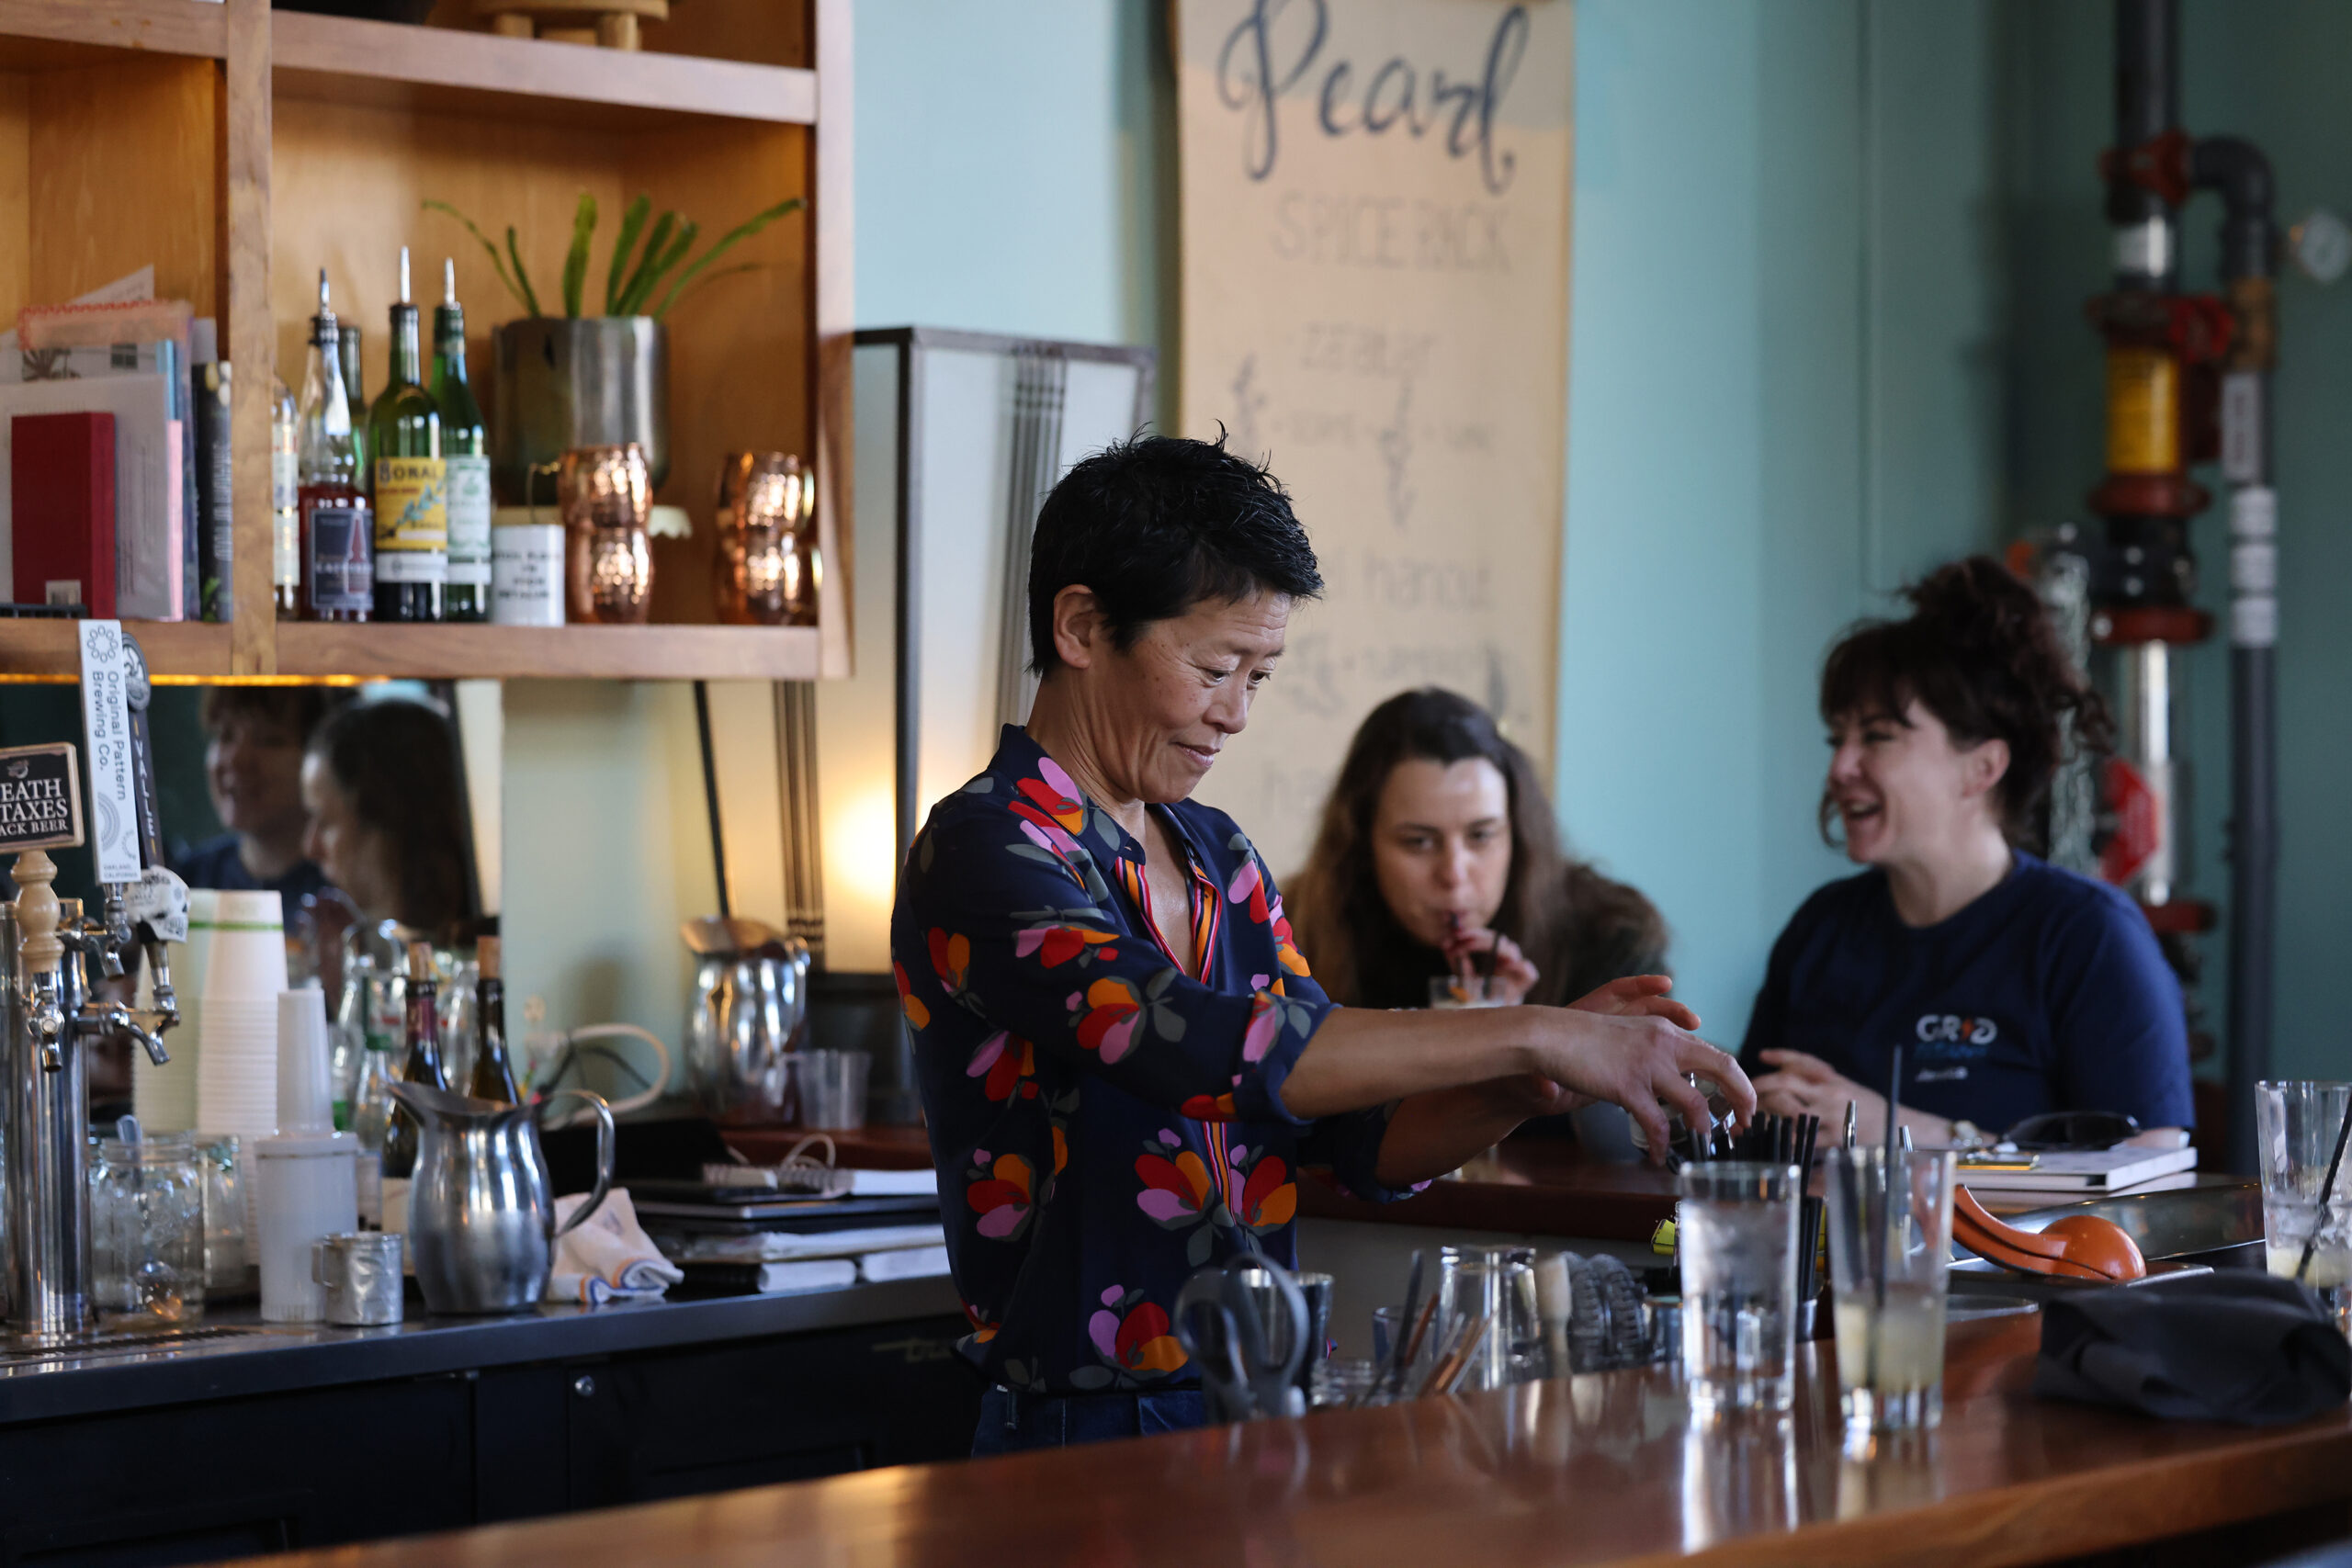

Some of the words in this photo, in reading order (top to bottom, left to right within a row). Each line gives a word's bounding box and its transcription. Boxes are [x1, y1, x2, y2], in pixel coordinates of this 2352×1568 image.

[1216, 0, 1530, 196] Pearl
[92, 671, 107, 739] Brewing
[107, 671, 125, 736] Original
[97, 743, 110, 772] Co.
[113, 740, 126, 801] Pattern
[135, 739, 157, 837] VALLE
[0, 777, 62, 802] EATH
[0, 797, 69, 823] TAXES
[0, 822, 28, 837] ACK
[31, 818, 69, 833] BEER
